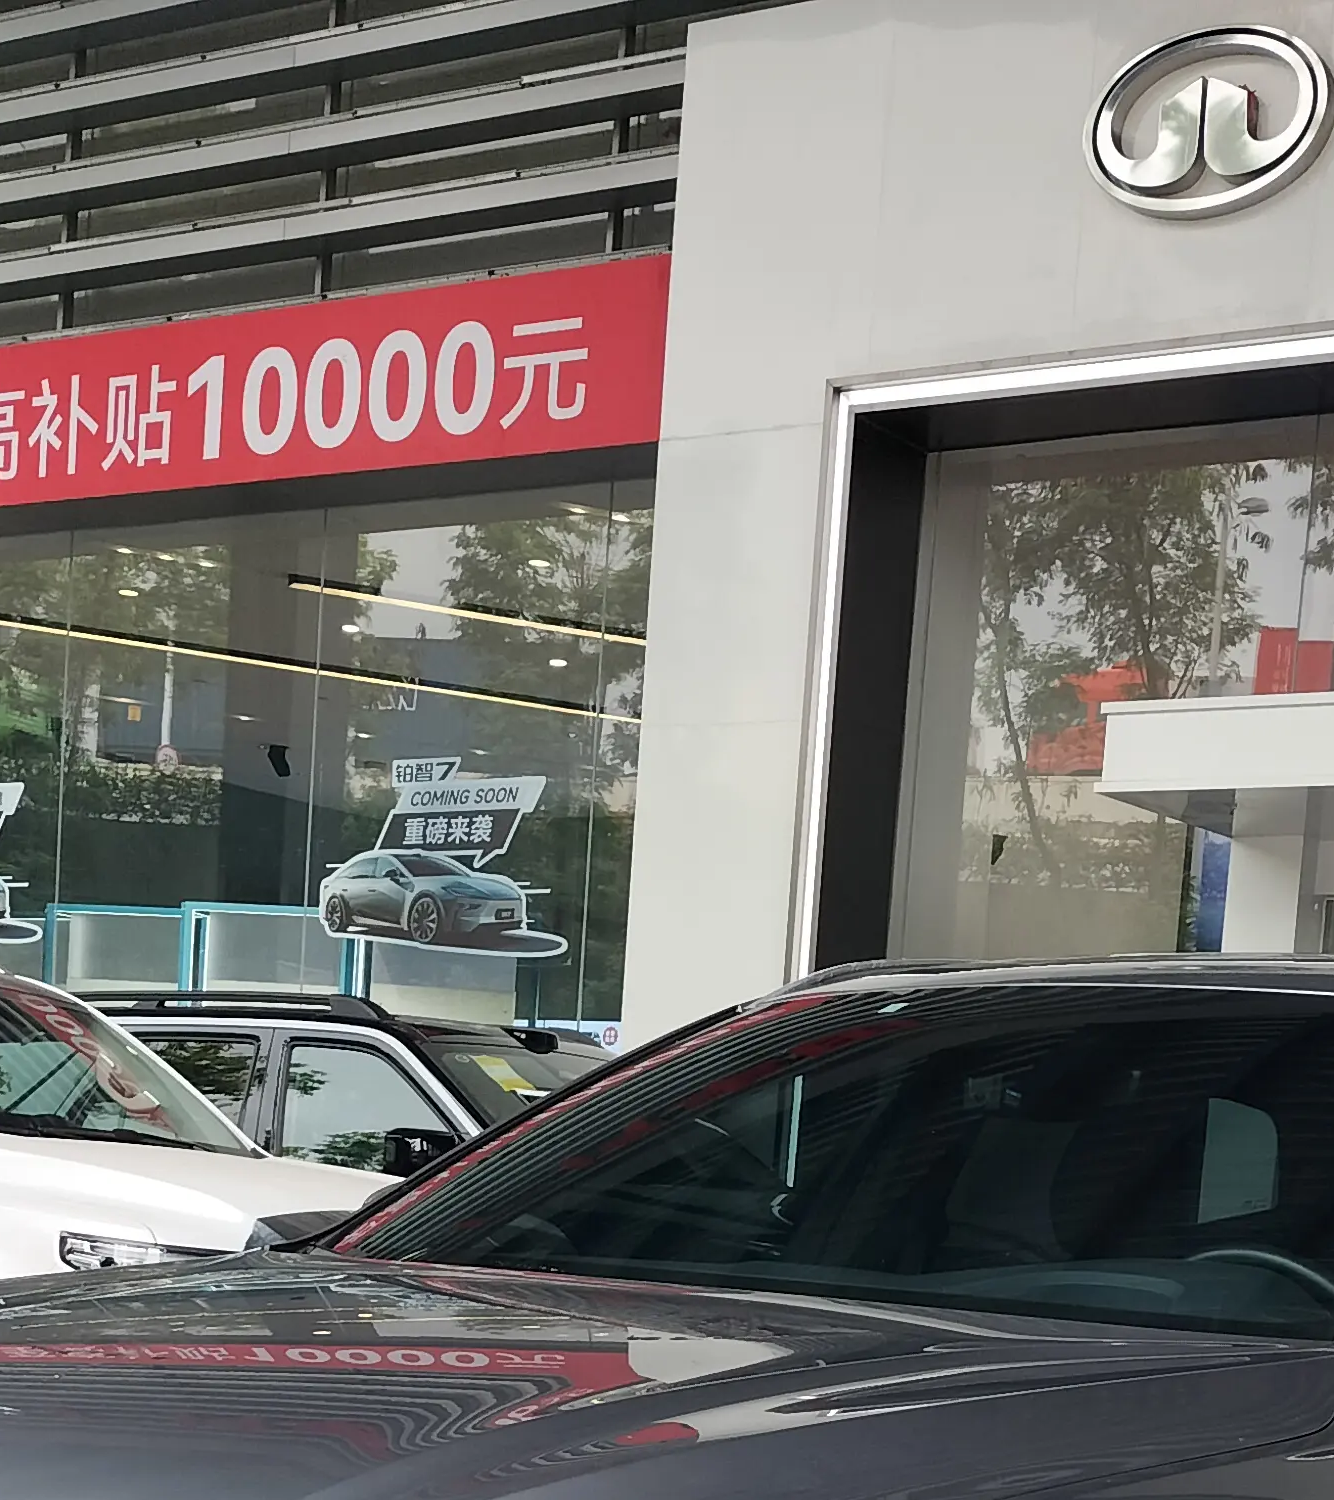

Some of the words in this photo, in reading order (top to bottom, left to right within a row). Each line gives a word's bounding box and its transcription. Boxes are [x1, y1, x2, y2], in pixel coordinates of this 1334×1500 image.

[395, 761, 457, 783] 铂智7
[410, 789, 471, 807] COMING
[473, 786, 520, 804] SOON
[402, 814, 494, 845] 重磅来袭
